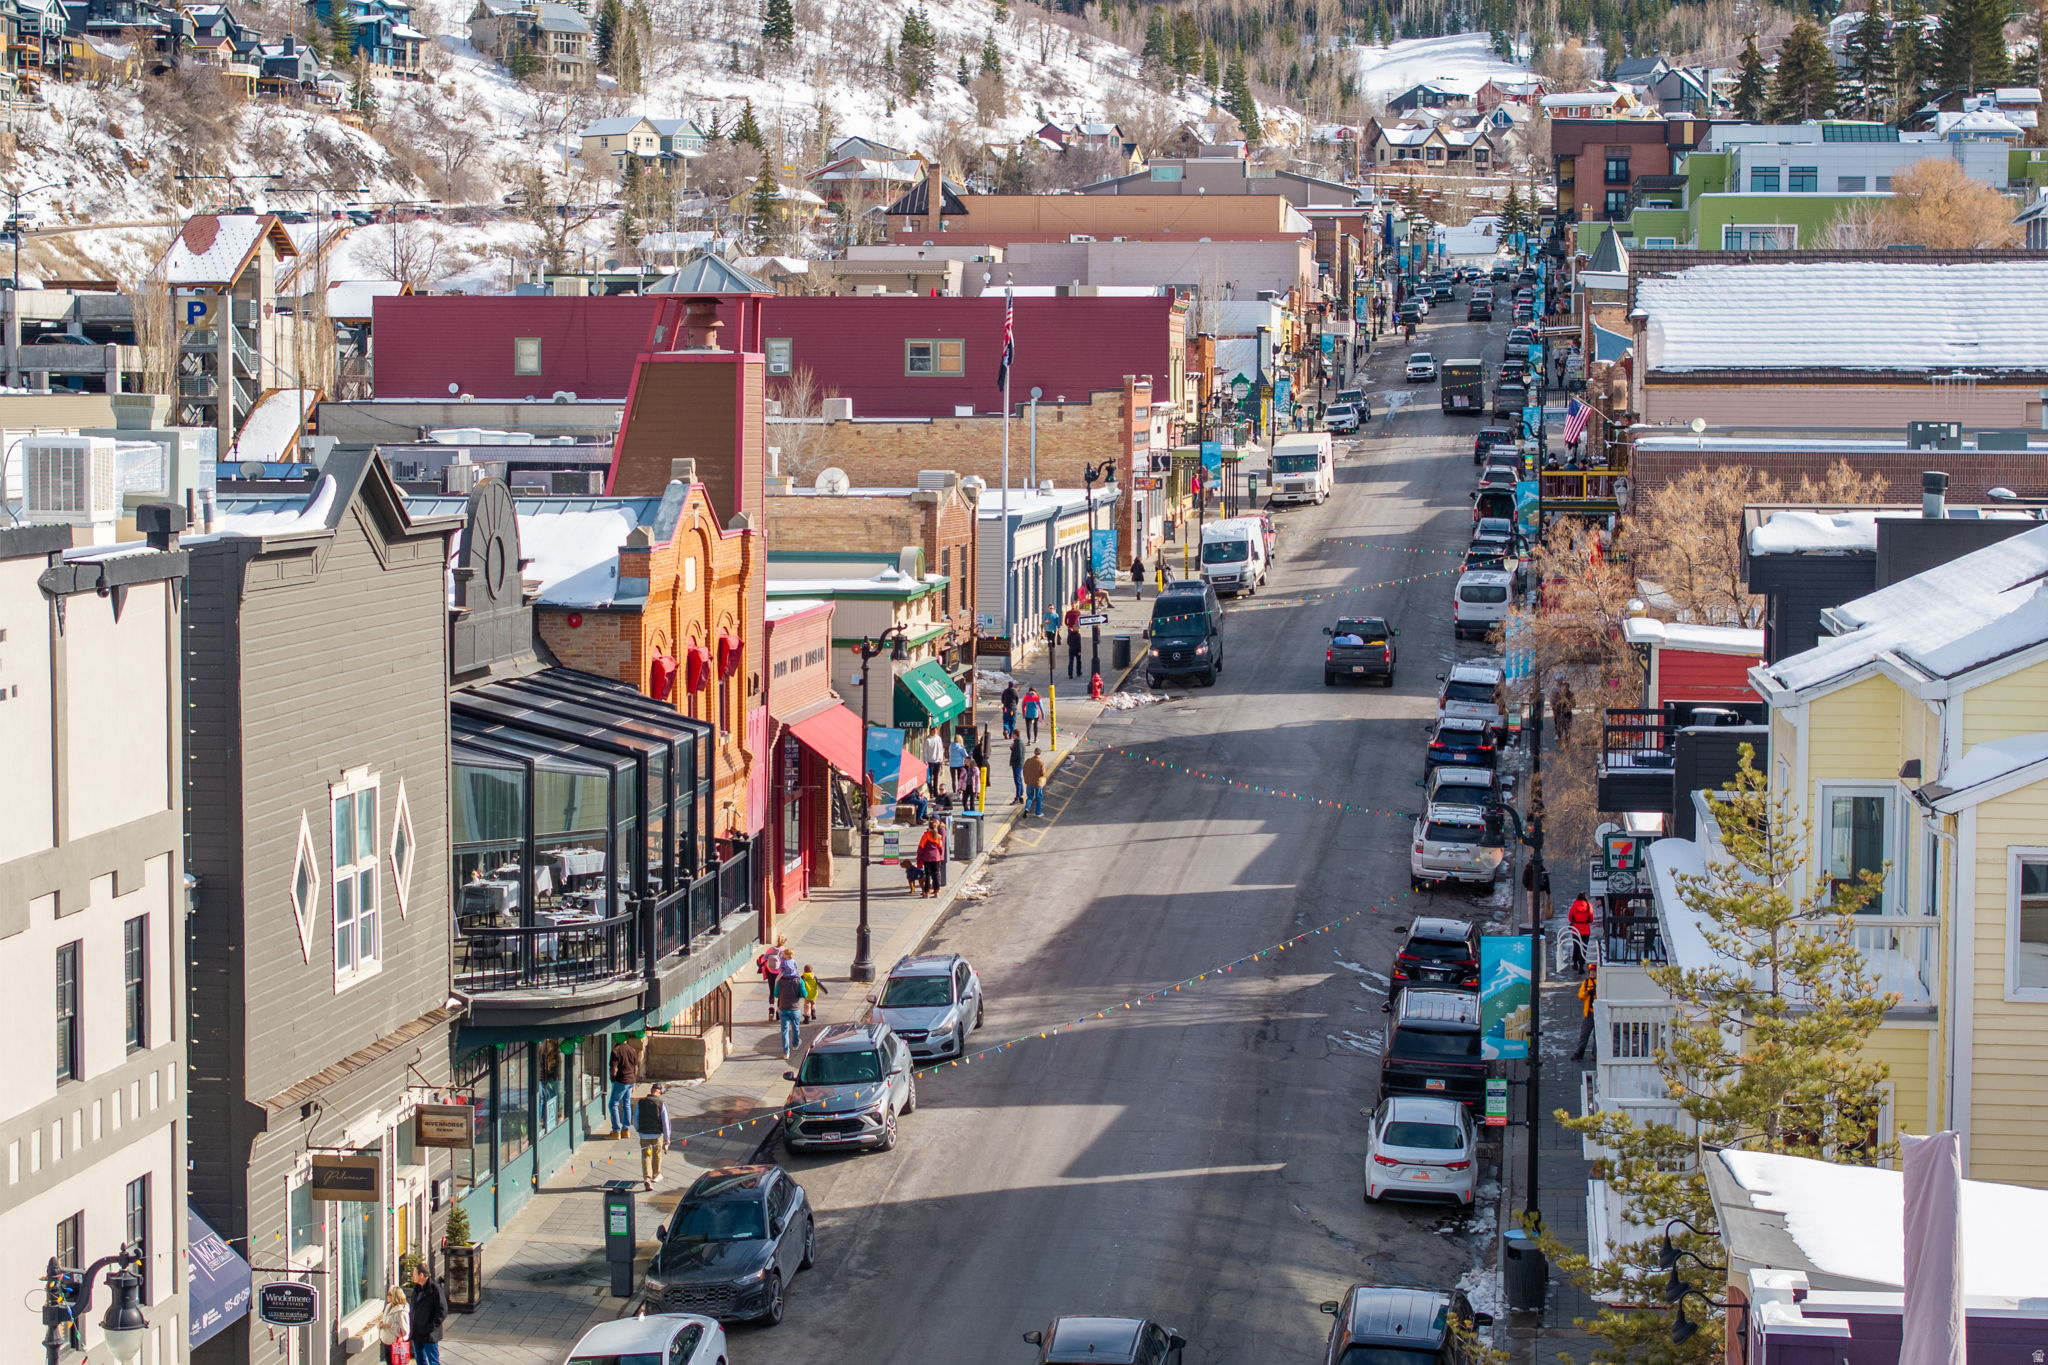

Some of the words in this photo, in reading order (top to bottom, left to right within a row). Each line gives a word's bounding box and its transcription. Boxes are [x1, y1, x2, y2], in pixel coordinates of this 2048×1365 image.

[187, 301, 207, 325] P
[1612, 842, 1632, 868] 7
[194, 1237, 229, 1263] MAIN
[265, 1293, 311, 1303] Windermere
